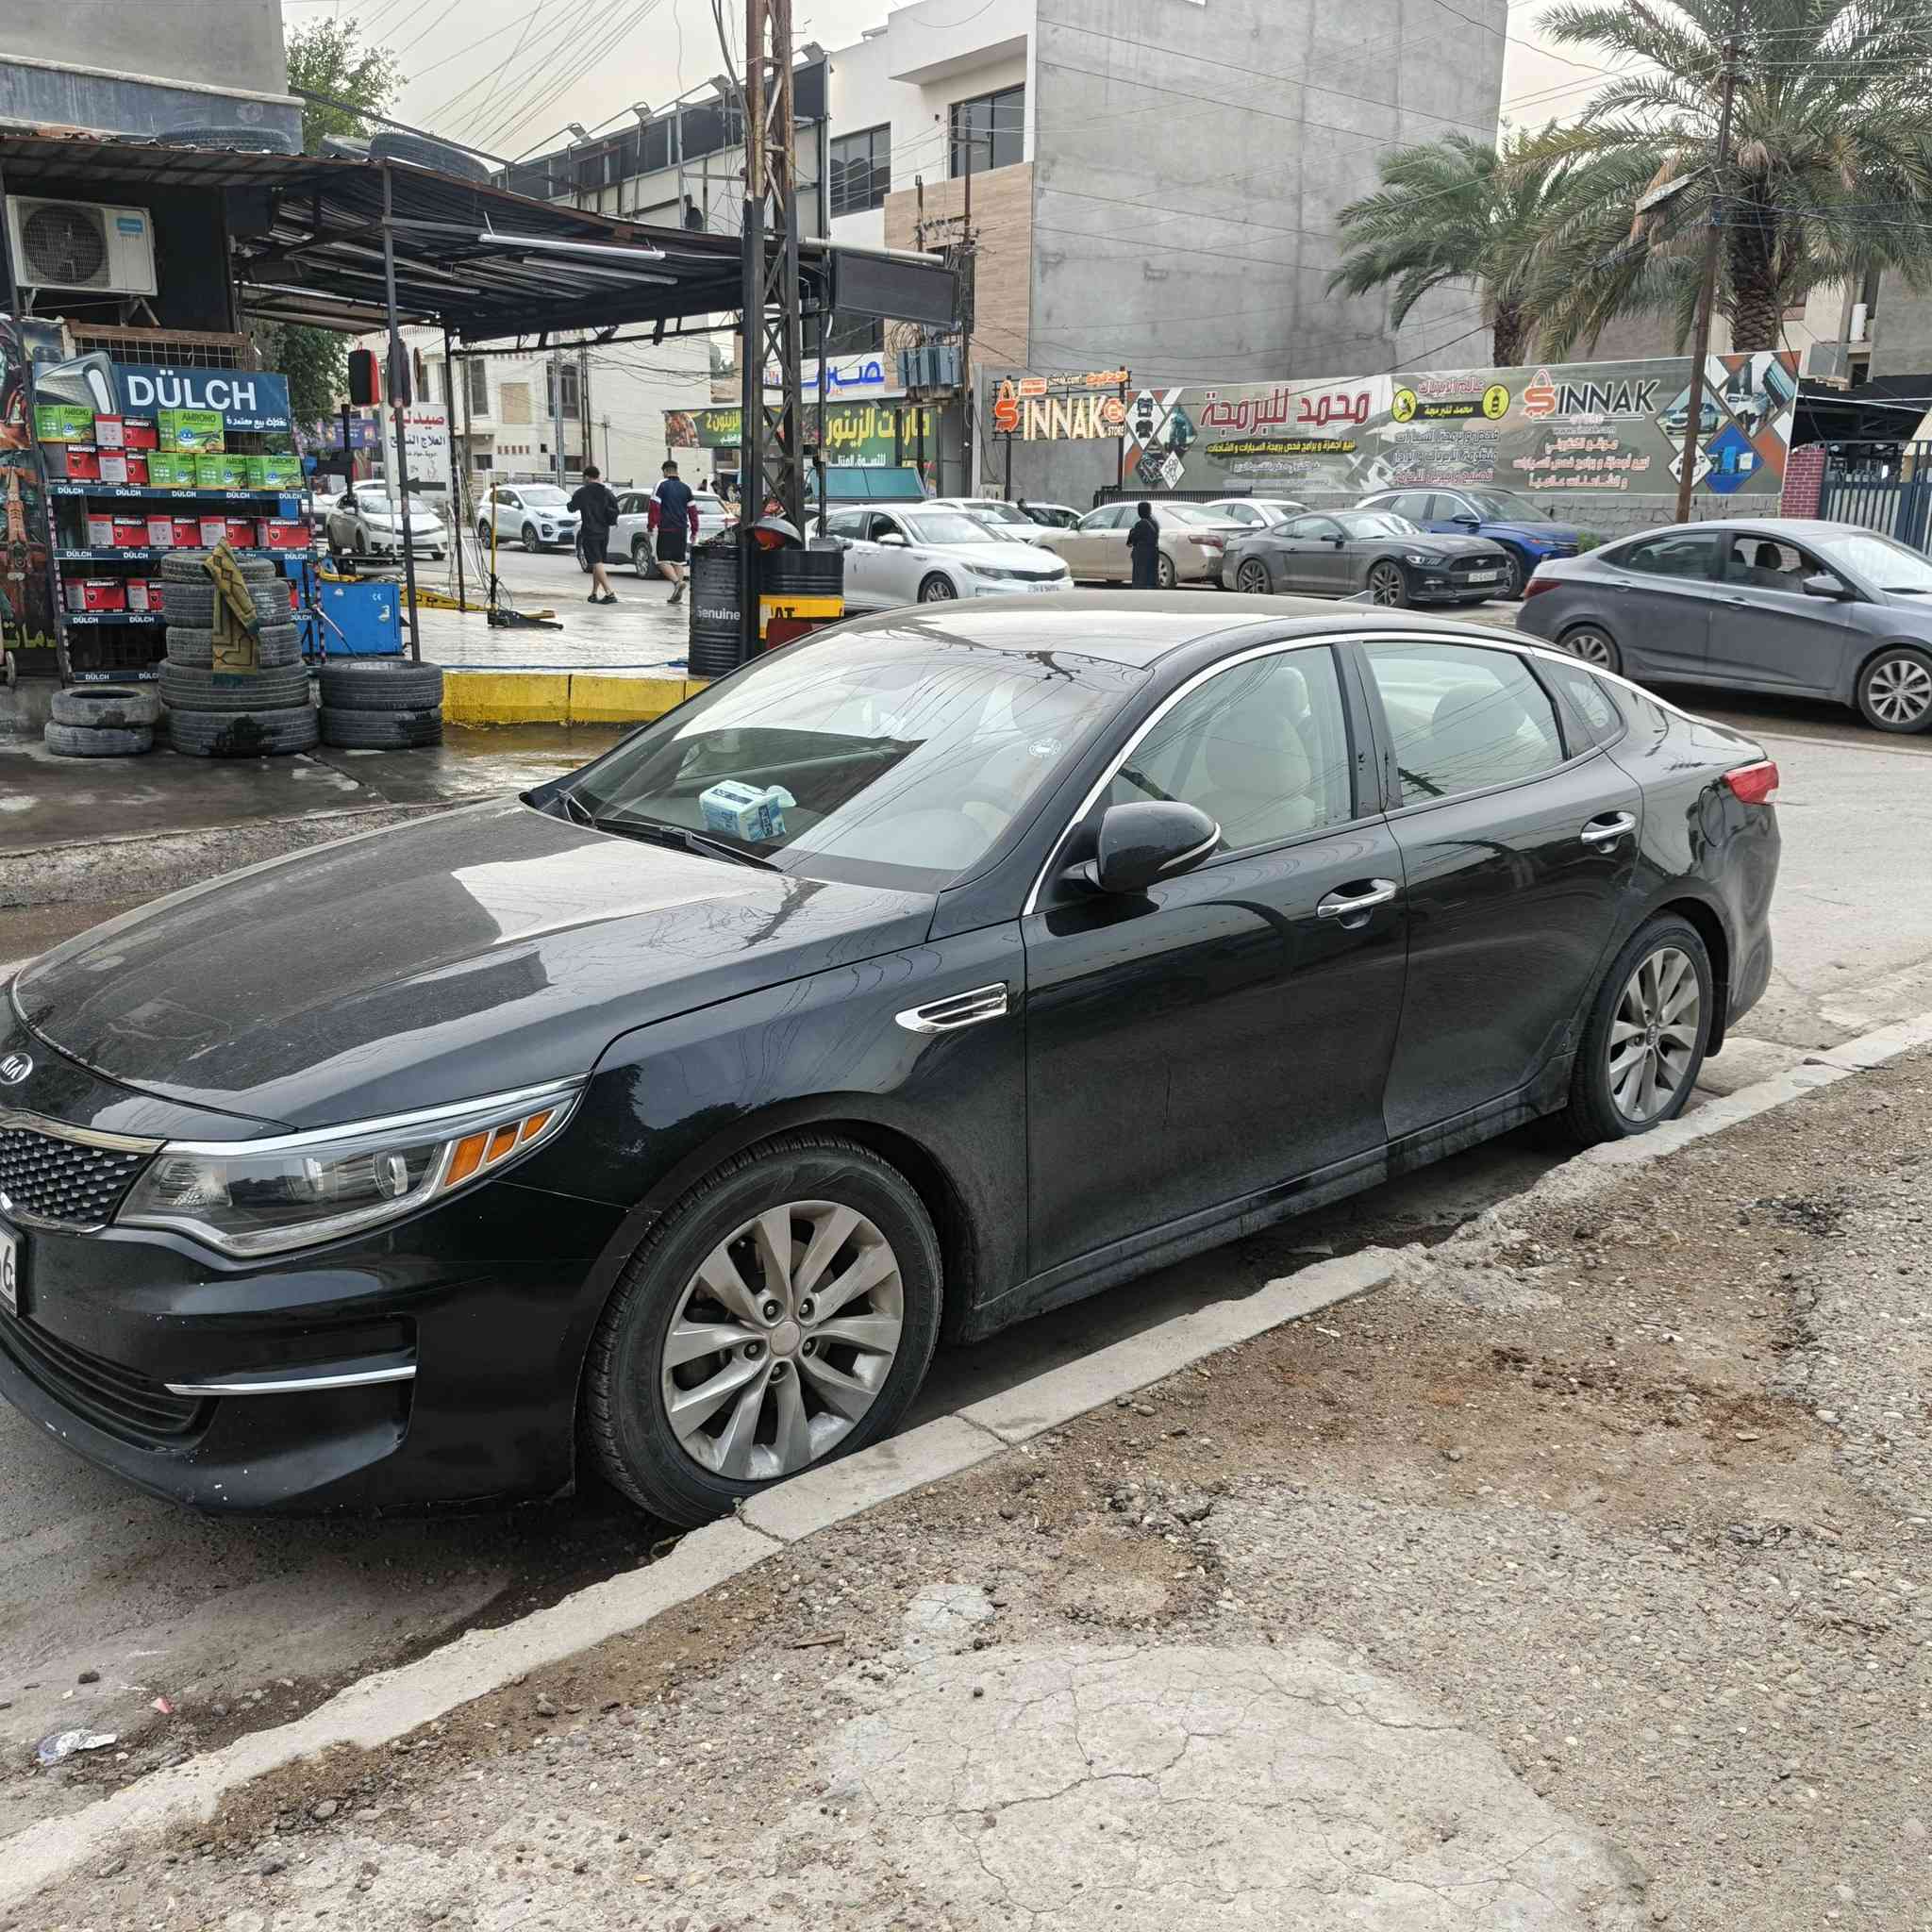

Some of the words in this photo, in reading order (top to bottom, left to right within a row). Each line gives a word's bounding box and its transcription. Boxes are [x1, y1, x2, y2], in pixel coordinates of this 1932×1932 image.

[127, 369, 257, 411] DÜLCH
[1524, 378, 1660, 417] SINNAK
[390, 409, 445, 430] صيدلة
[995, 394, 1108, 441] SINNAK
[1200, 386, 1291, 437] للبرمجة
[1296, 391, 1372, 426] محمد
[1424, 404, 1453, 418] للبرمجة
[1453, 406, 1474, 416] محمد
[254, 419, 264, 429] بيع
[139, 671, 159, 679] DÜLC
